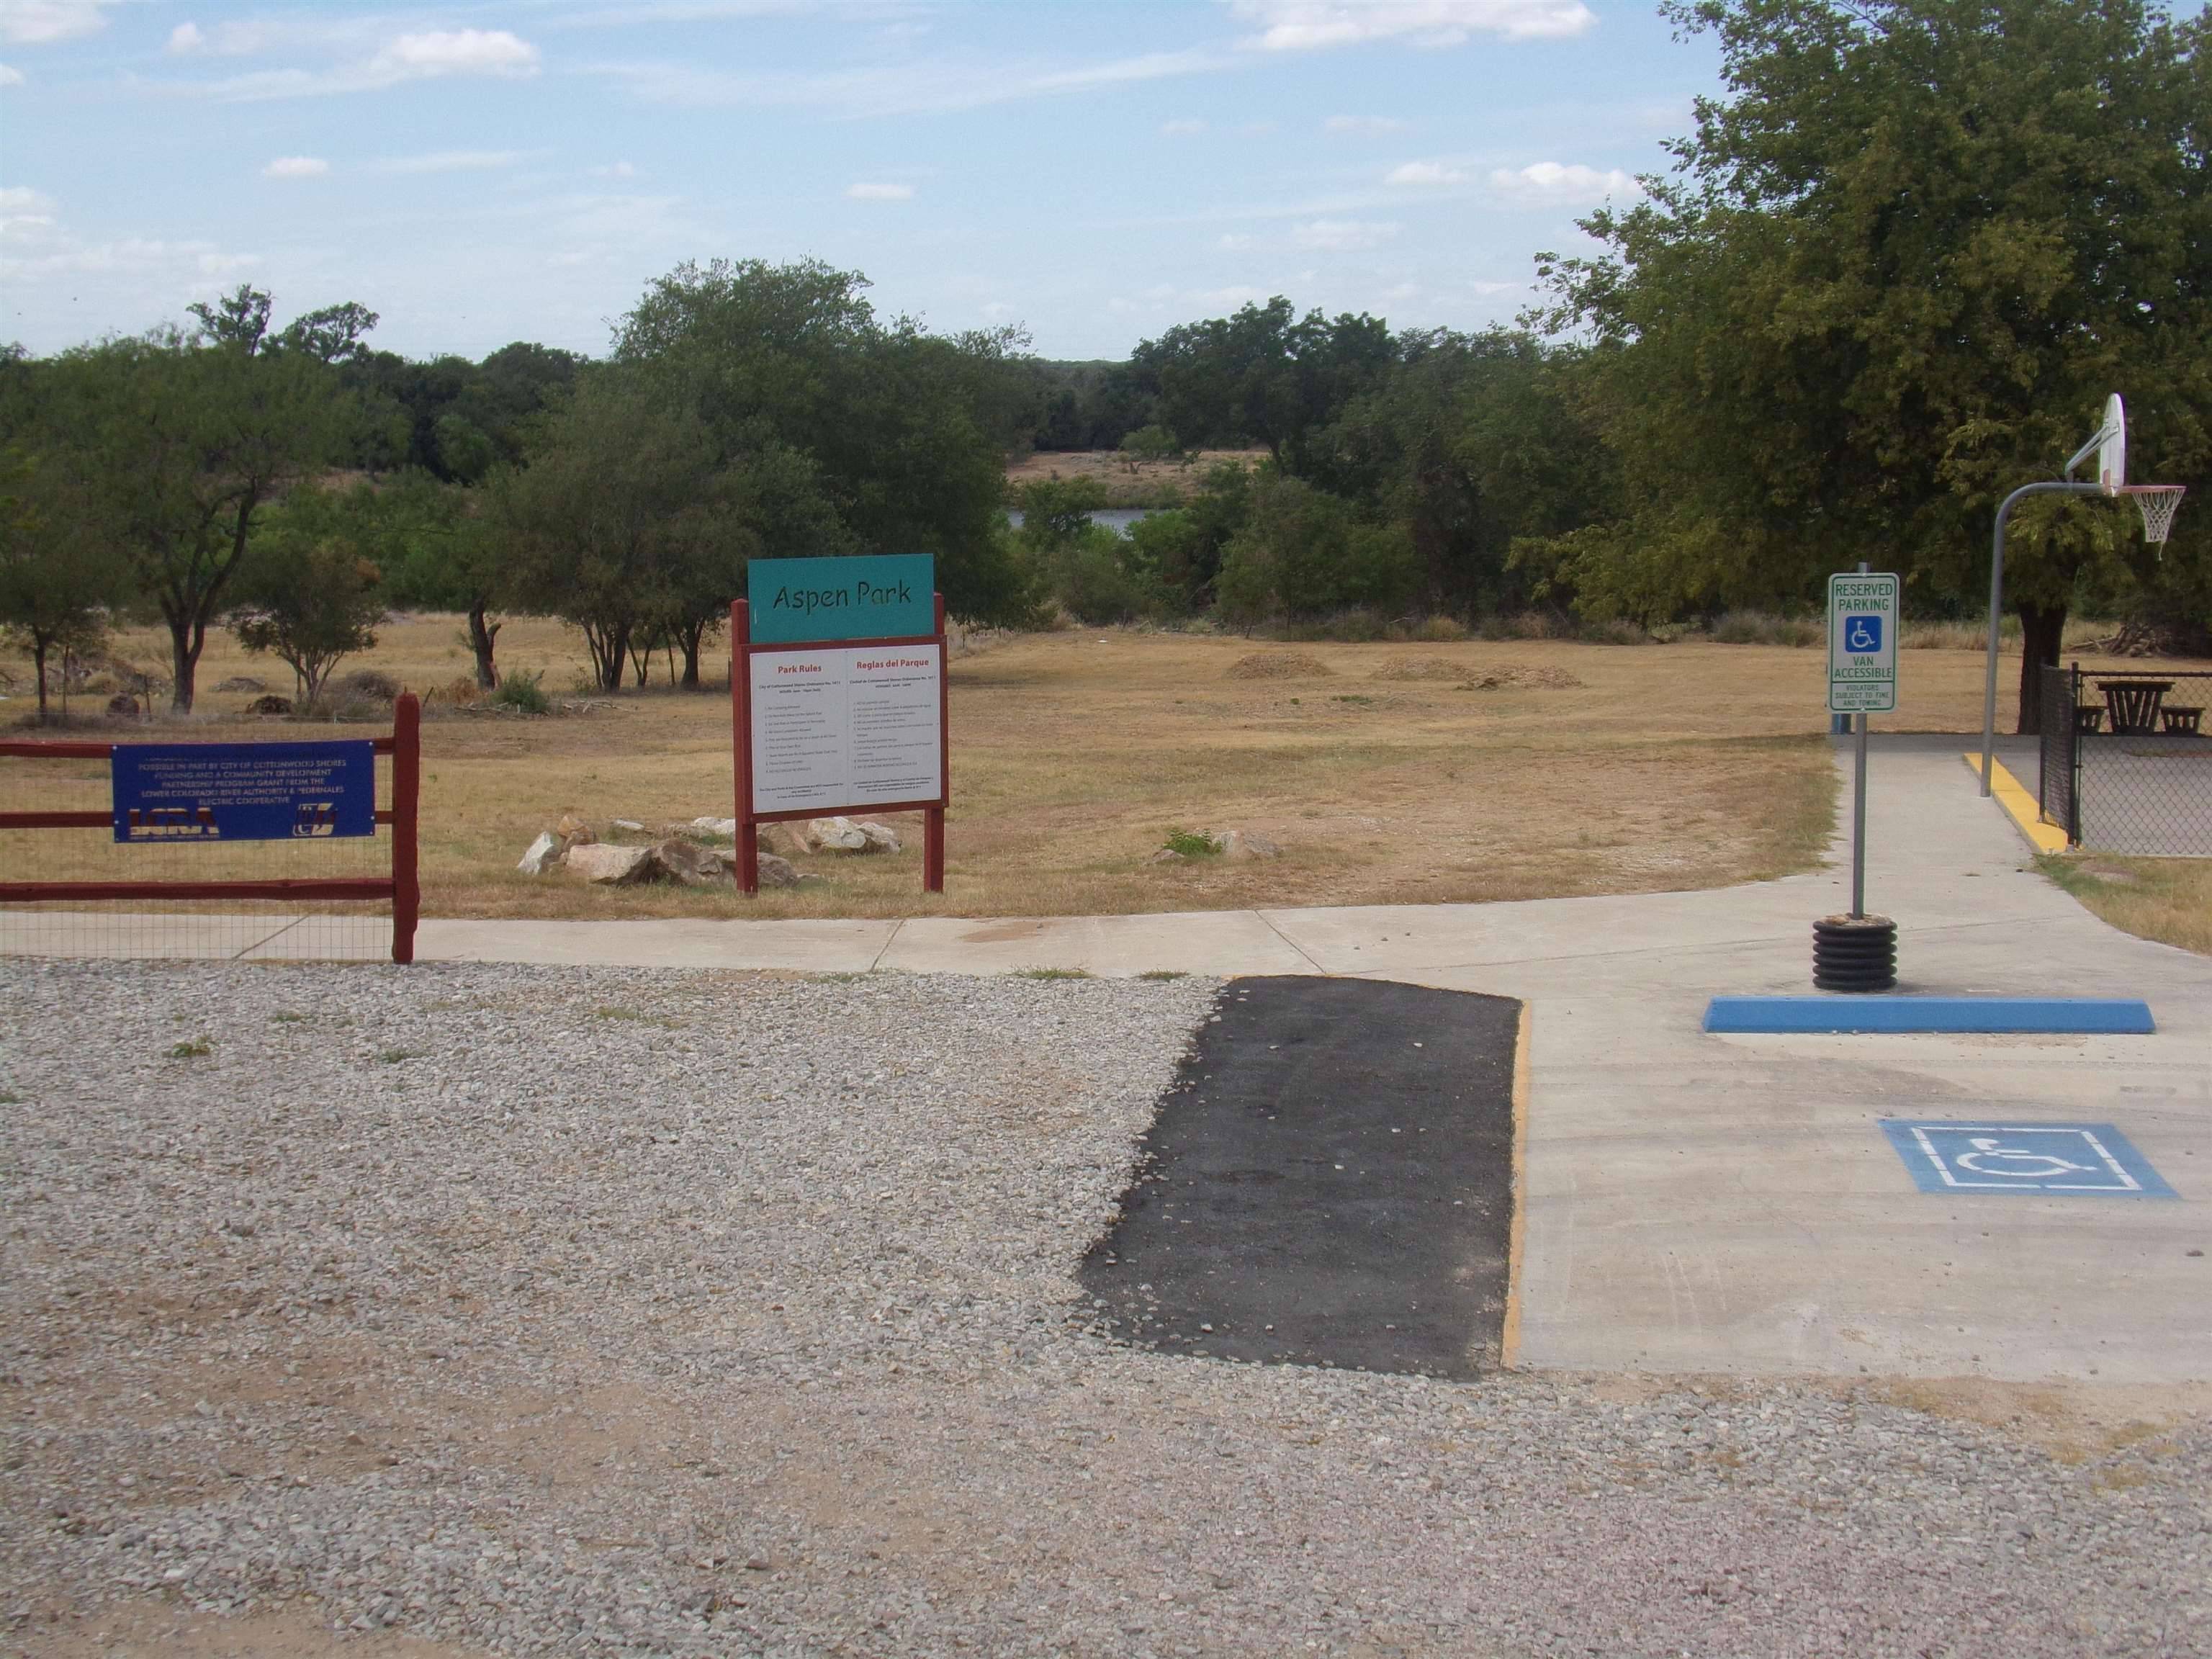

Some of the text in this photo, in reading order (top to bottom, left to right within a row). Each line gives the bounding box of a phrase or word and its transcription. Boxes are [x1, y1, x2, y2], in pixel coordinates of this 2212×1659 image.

[1835, 584, 1892, 595] RESERVED
[773, 580, 912, 616] Aspen Park
[1839, 599, 1889, 611] PARKING
[857, 661, 884, 670] Reglas
[901, 660, 929, 668] Parque
[1853, 657, 1874, 665] VAN
[778, 664, 822, 674] Park Rules
[1835, 667, 1892, 678] ACCESSIBLE
[223, 769, 274, 778] COMMUNITY
[276, 768, 332, 777] DEVELOPMENT
